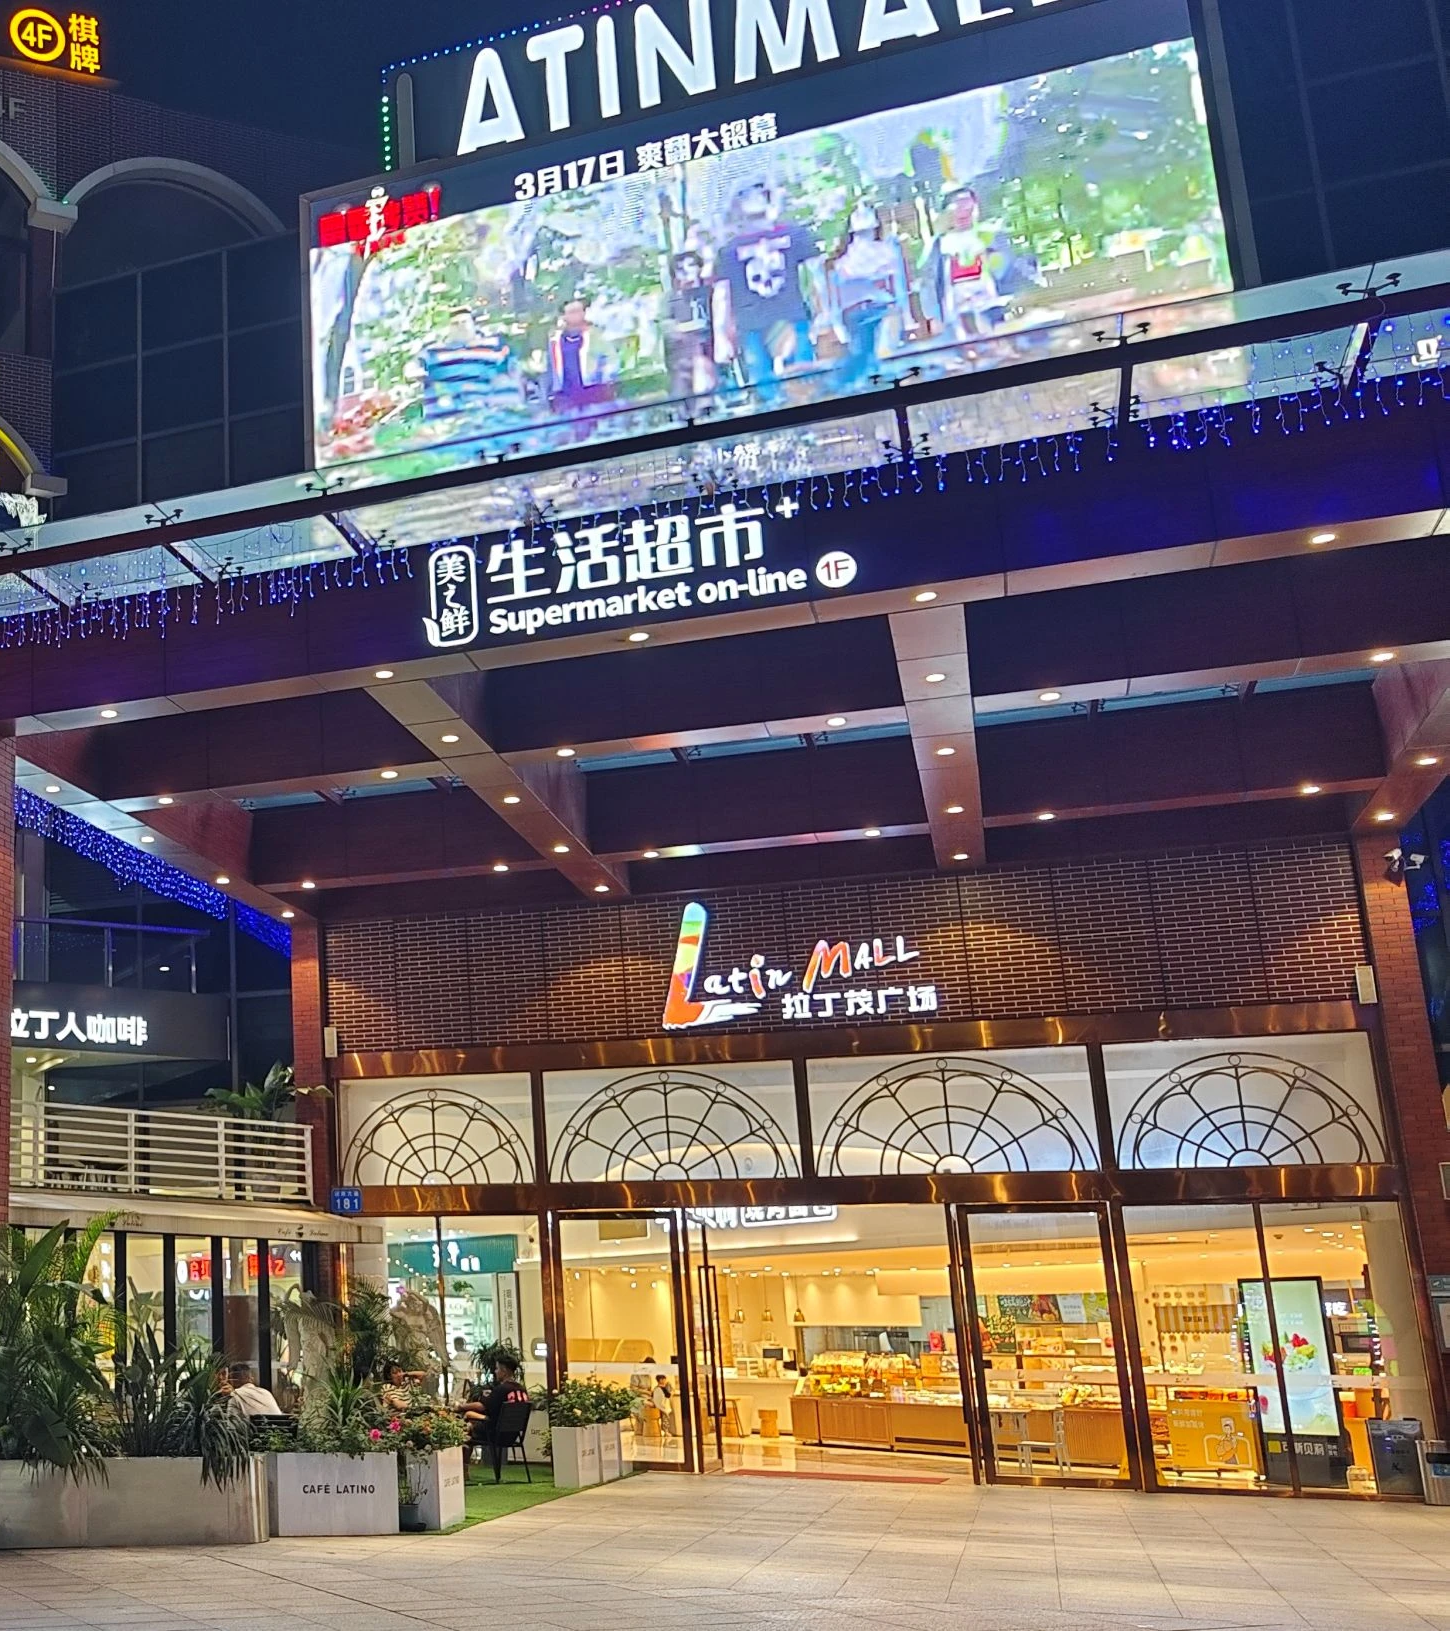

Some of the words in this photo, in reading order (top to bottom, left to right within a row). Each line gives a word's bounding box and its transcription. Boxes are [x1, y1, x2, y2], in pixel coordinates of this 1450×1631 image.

[19, 21, 54, 50] 4F
[68, 13, 101, 74] 棋牌
[514, 149, 625, 200] 3月17日
[490, 582, 689, 634] Supermarket
[700, 565, 807, 603] on-line
[820, 559, 849, 582] 1F
[781, 985, 938, 1019] 拉丁茂广场
[336, 1198, 359, 1210] 181
[336, 1483, 376, 1495] LATINO
